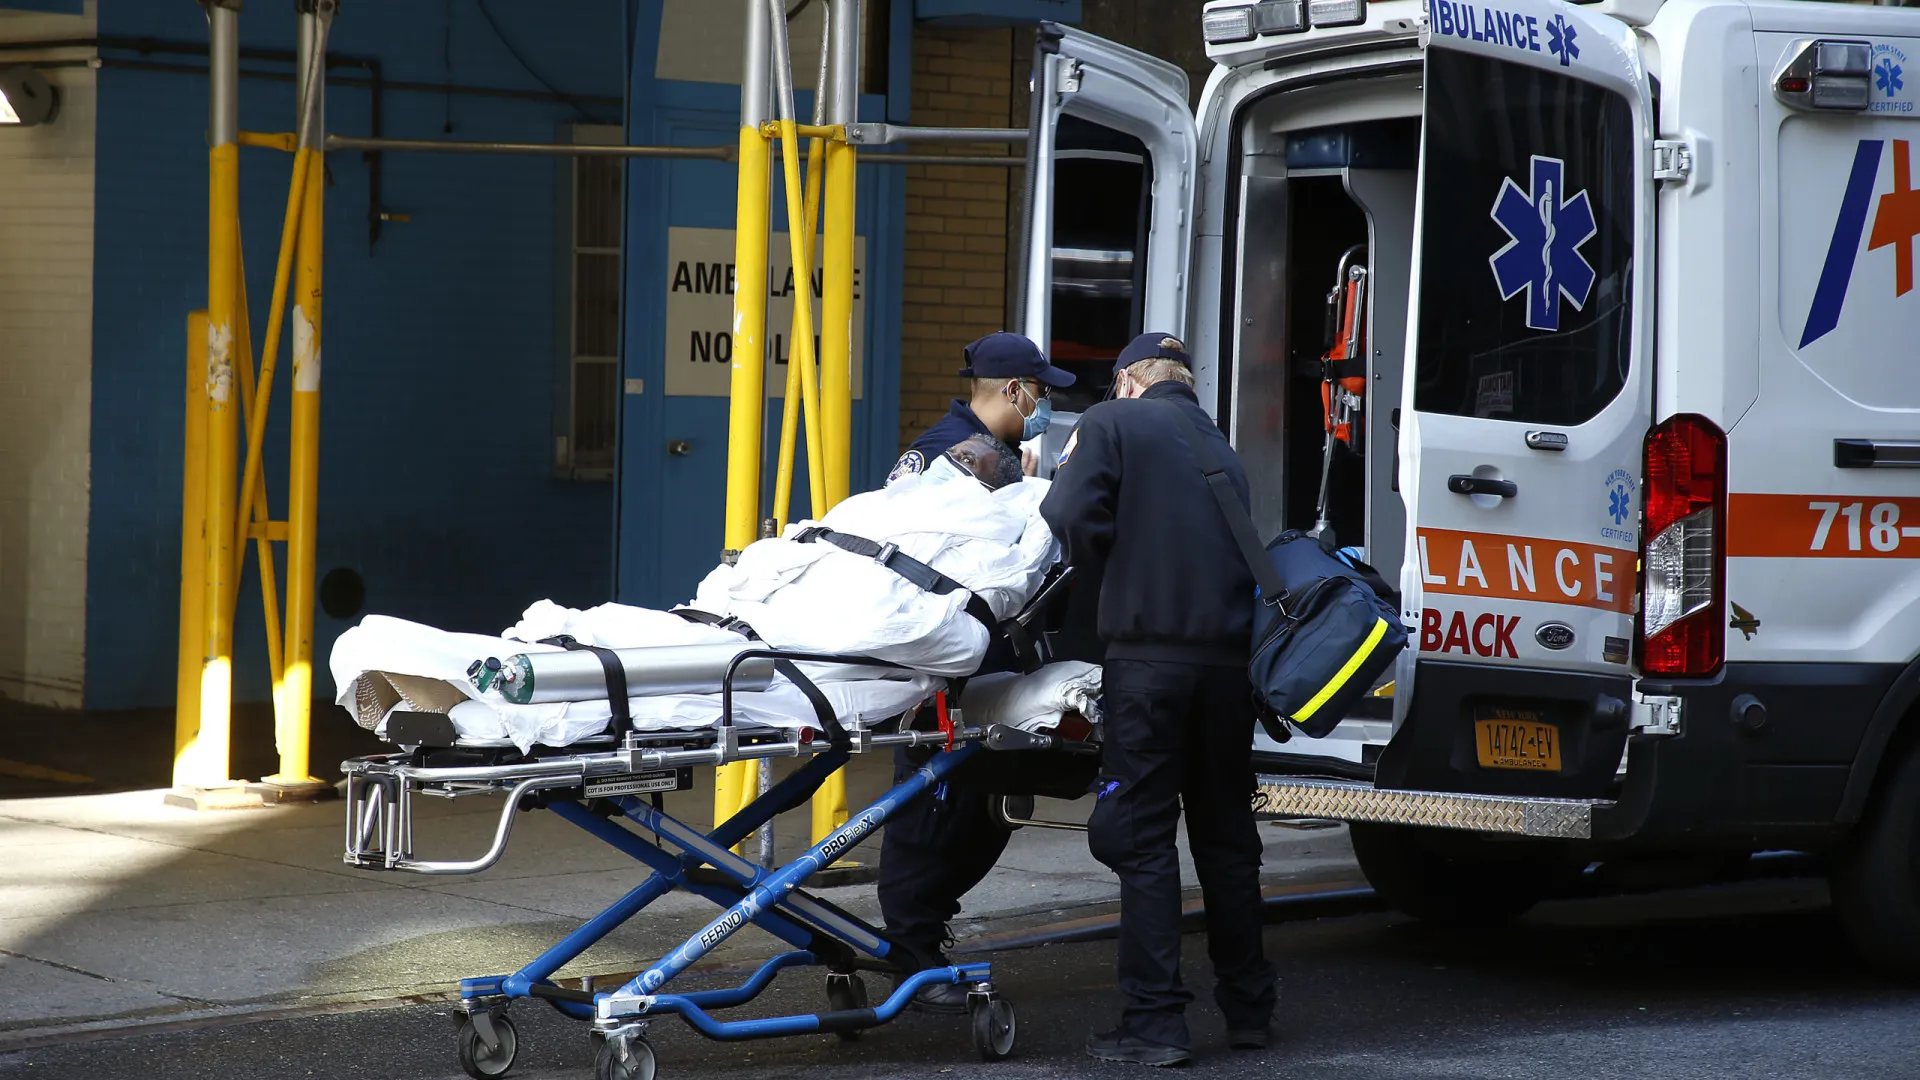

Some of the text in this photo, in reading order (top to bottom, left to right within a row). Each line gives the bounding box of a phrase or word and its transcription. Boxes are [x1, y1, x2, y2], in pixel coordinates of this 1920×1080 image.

[1870, 102, 1913, 112] CERTIFIED
[1601, 527, 1633, 543] CERTIFIED
[1420, 607, 1521, 659] BACK
[1496, 709, 1538, 721] NEW YORK
[1500, 757, 1541, 768] AMBULANCE
[614, 782, 650, 791] PROFESSIONAL
[661, 779, 674, 787] ONLY
[700, 911, 742, 949] FERNO
